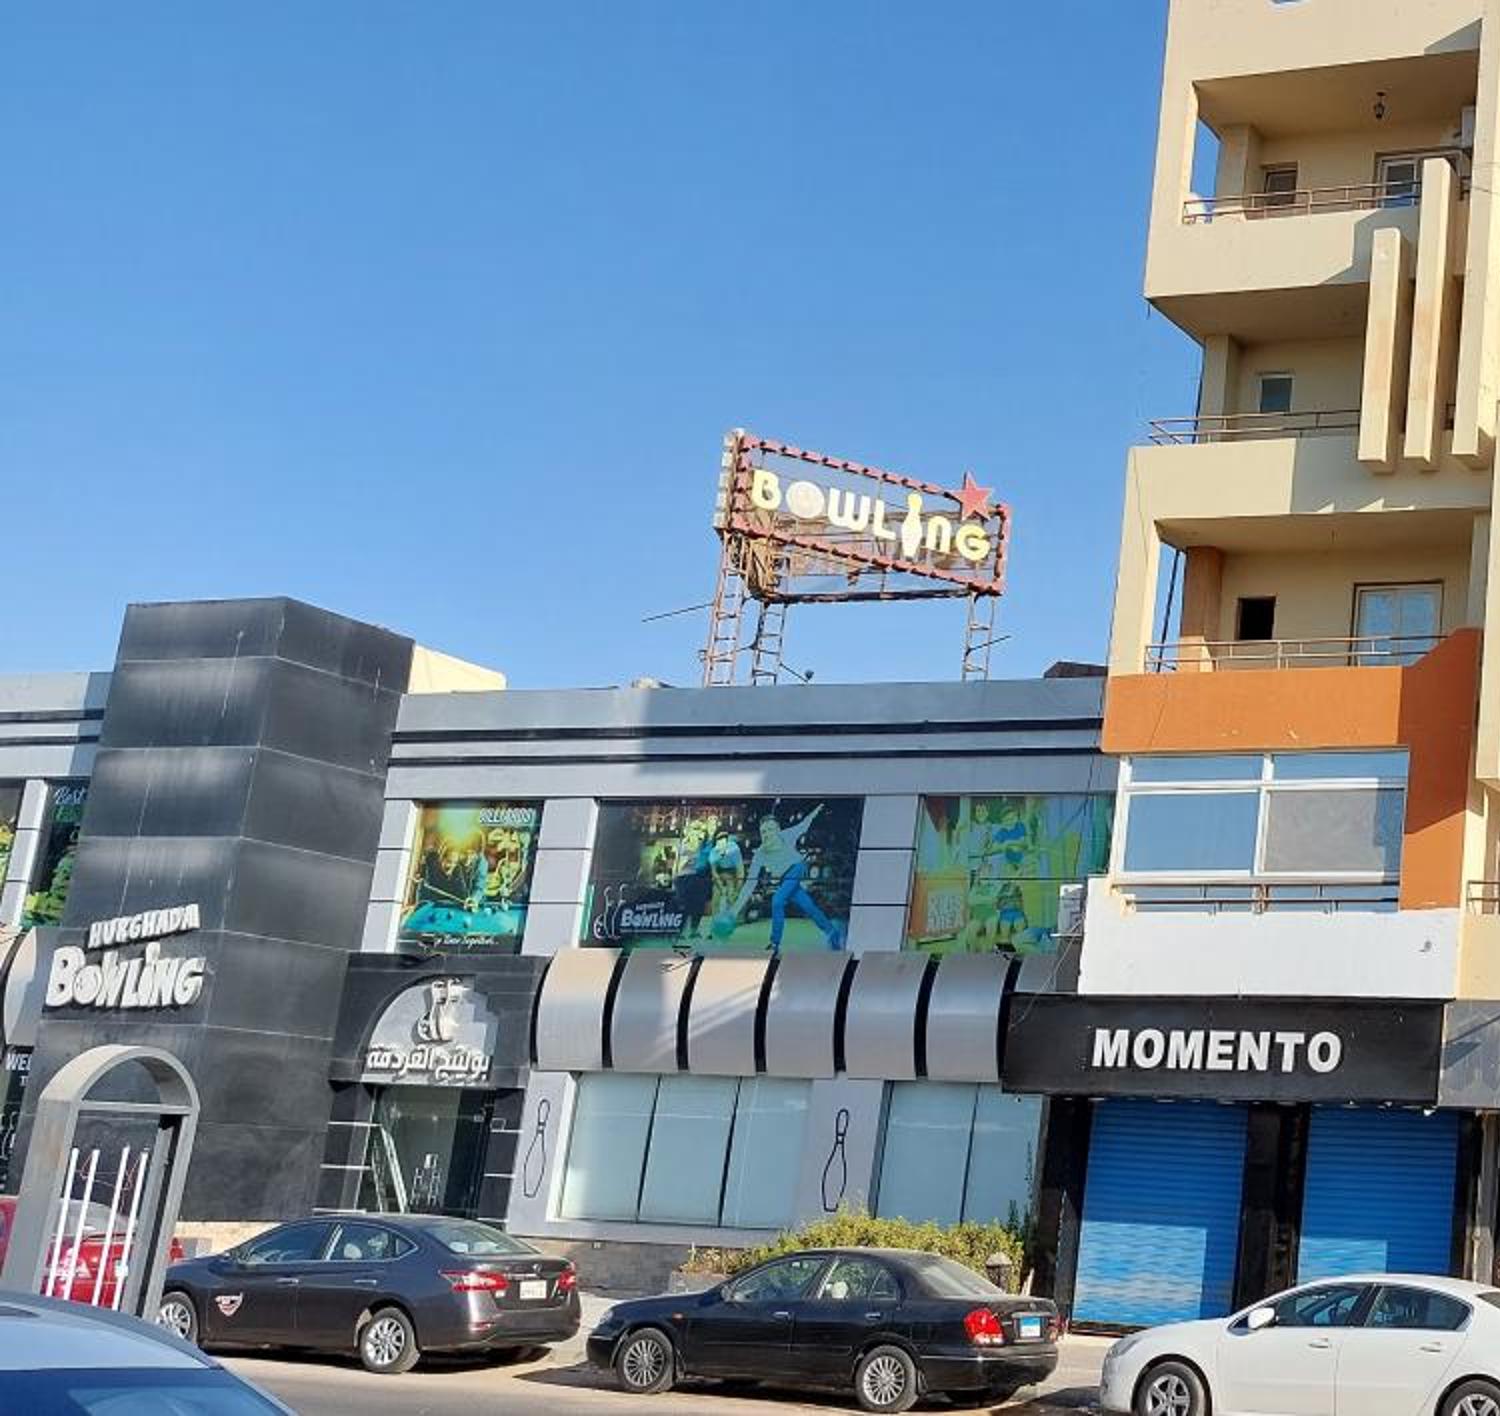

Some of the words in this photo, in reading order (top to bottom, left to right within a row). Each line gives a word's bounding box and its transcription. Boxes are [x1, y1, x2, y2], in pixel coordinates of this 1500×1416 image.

[752, 469, 991, 561] BOWLING
[87, 903, 200, 949] HURGHADA
[620, 907, 682, 928] BOWLING
[46, 941, 206, 1008] BOWLING
[1092, 1028, 1342, 1073] MOMENTO
